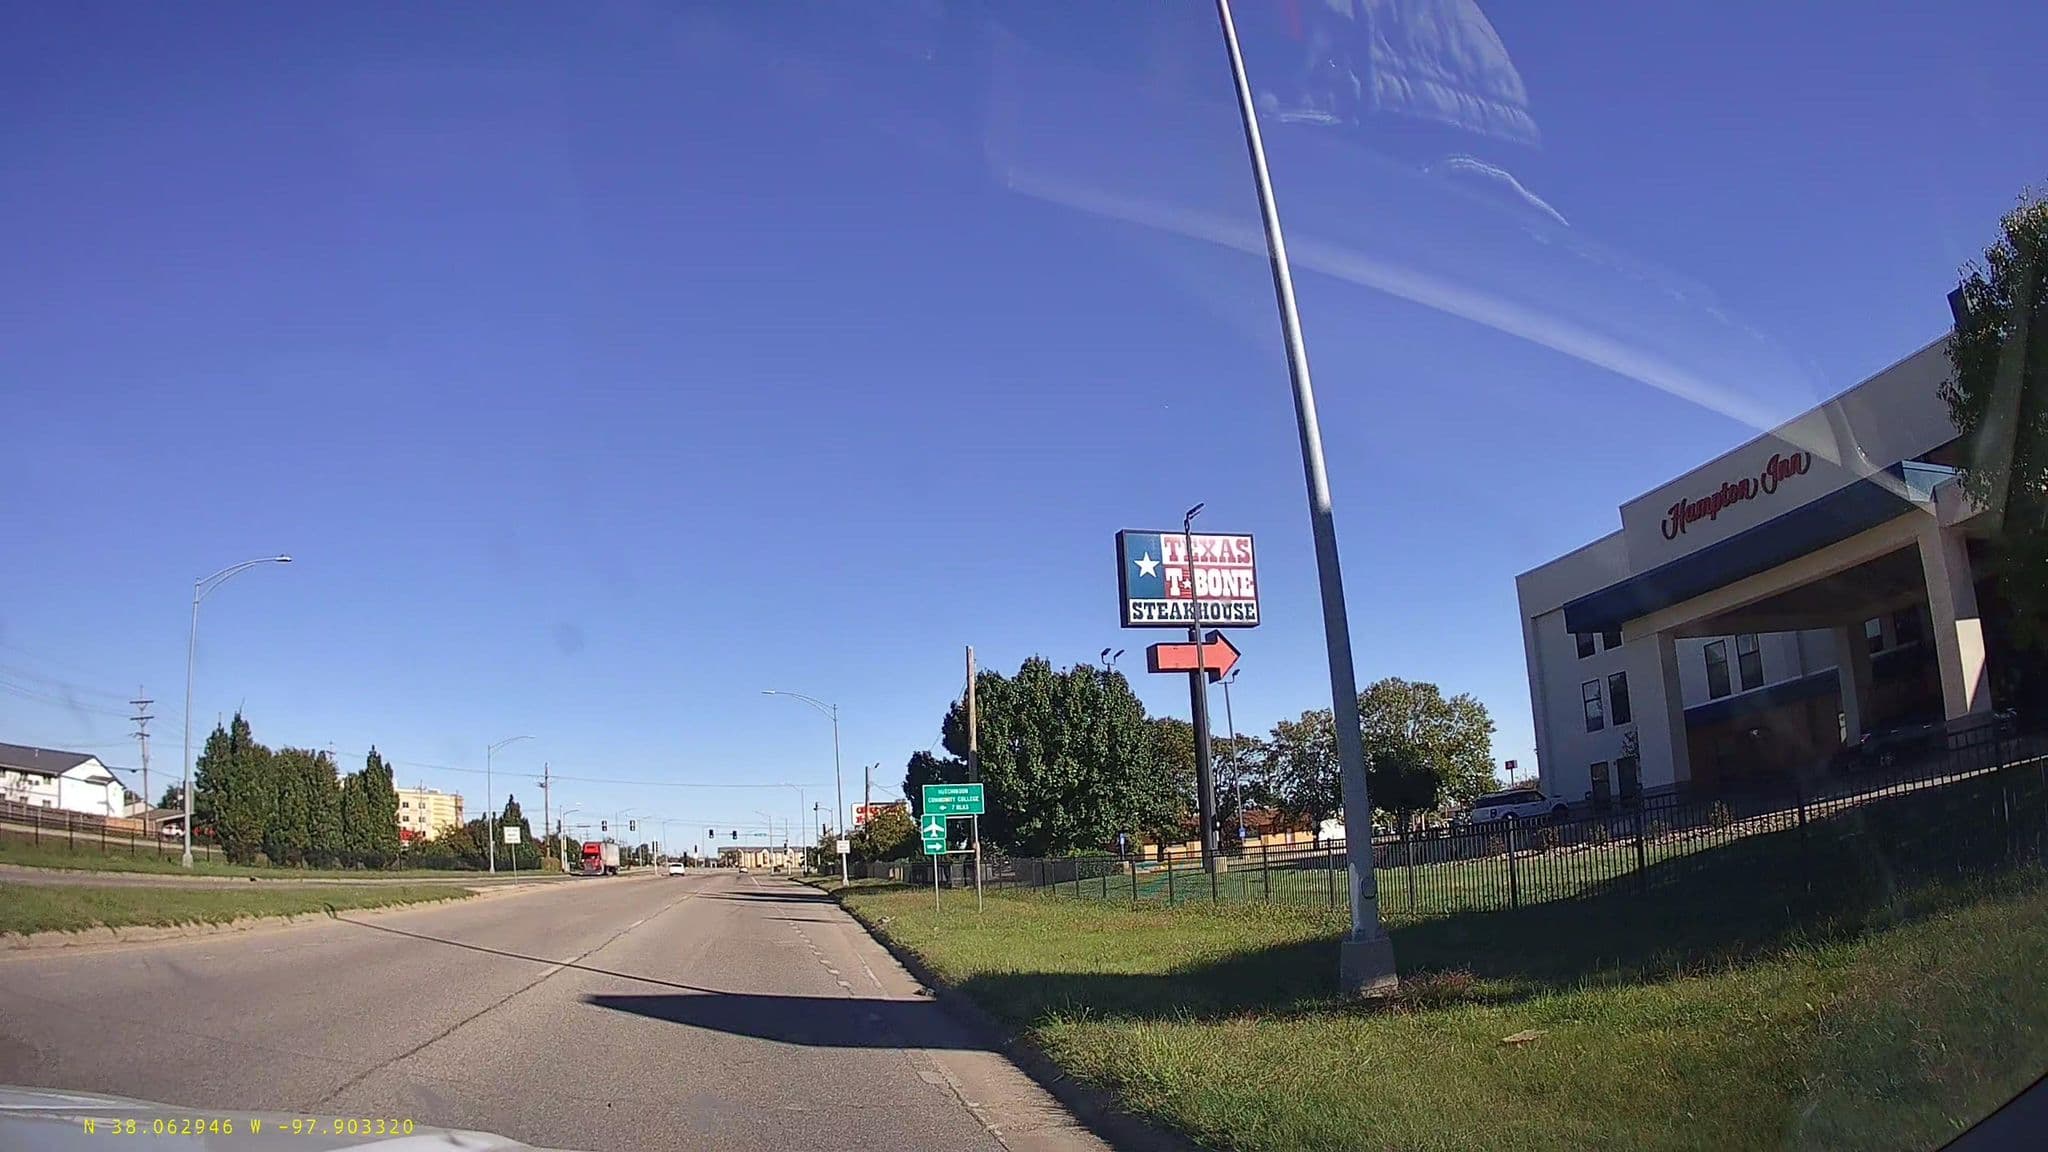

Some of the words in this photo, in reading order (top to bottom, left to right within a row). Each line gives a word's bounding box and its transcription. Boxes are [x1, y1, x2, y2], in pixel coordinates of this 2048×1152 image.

[1661, 478, 1759, 540] Hampton
[1761, 452, 1812, 494] Inn
[1164, 537, 1251, 564] TEXAS
[1132, 602, 1256, 620] STEAKHOUSE
